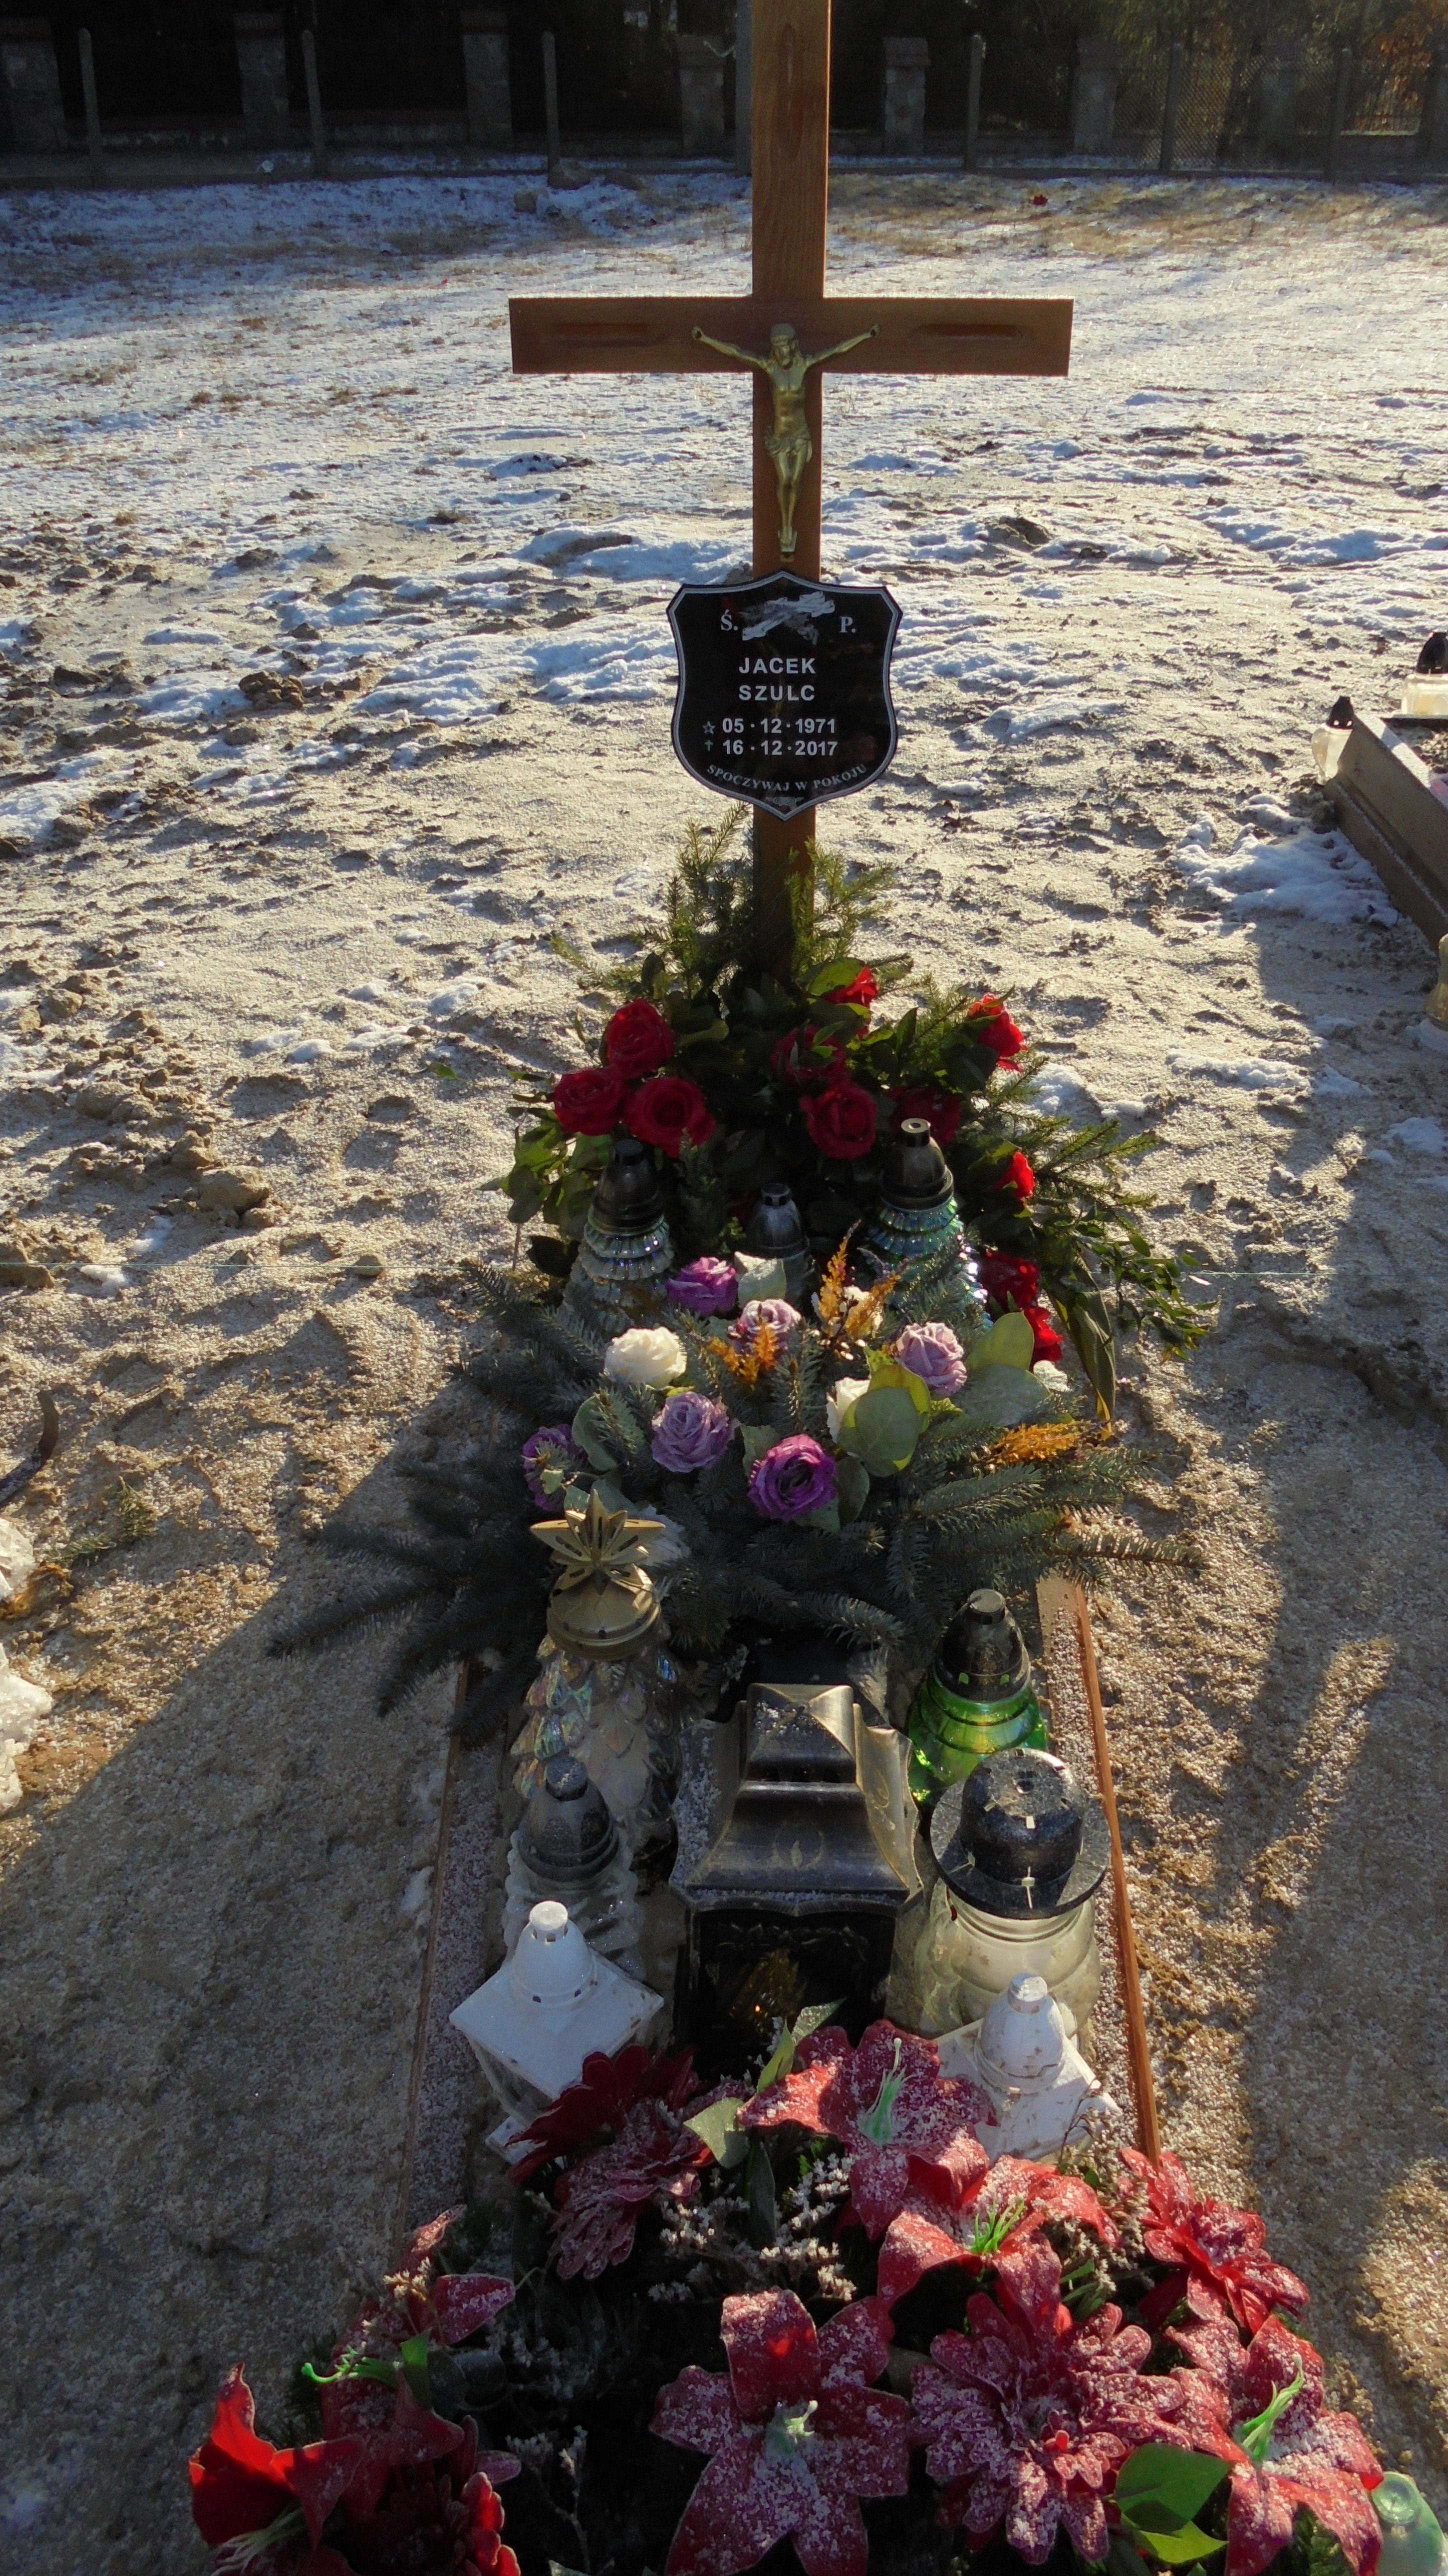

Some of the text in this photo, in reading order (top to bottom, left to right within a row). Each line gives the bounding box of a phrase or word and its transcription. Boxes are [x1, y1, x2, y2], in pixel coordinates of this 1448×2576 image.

[720, 609, 856, 633] Ś. P.
[739, 658, 816, 674] JACEK
[739, 685, 816, 701] SZULC
[706, 764, 868, 792] SPOCZYWAJ W POKOJU
